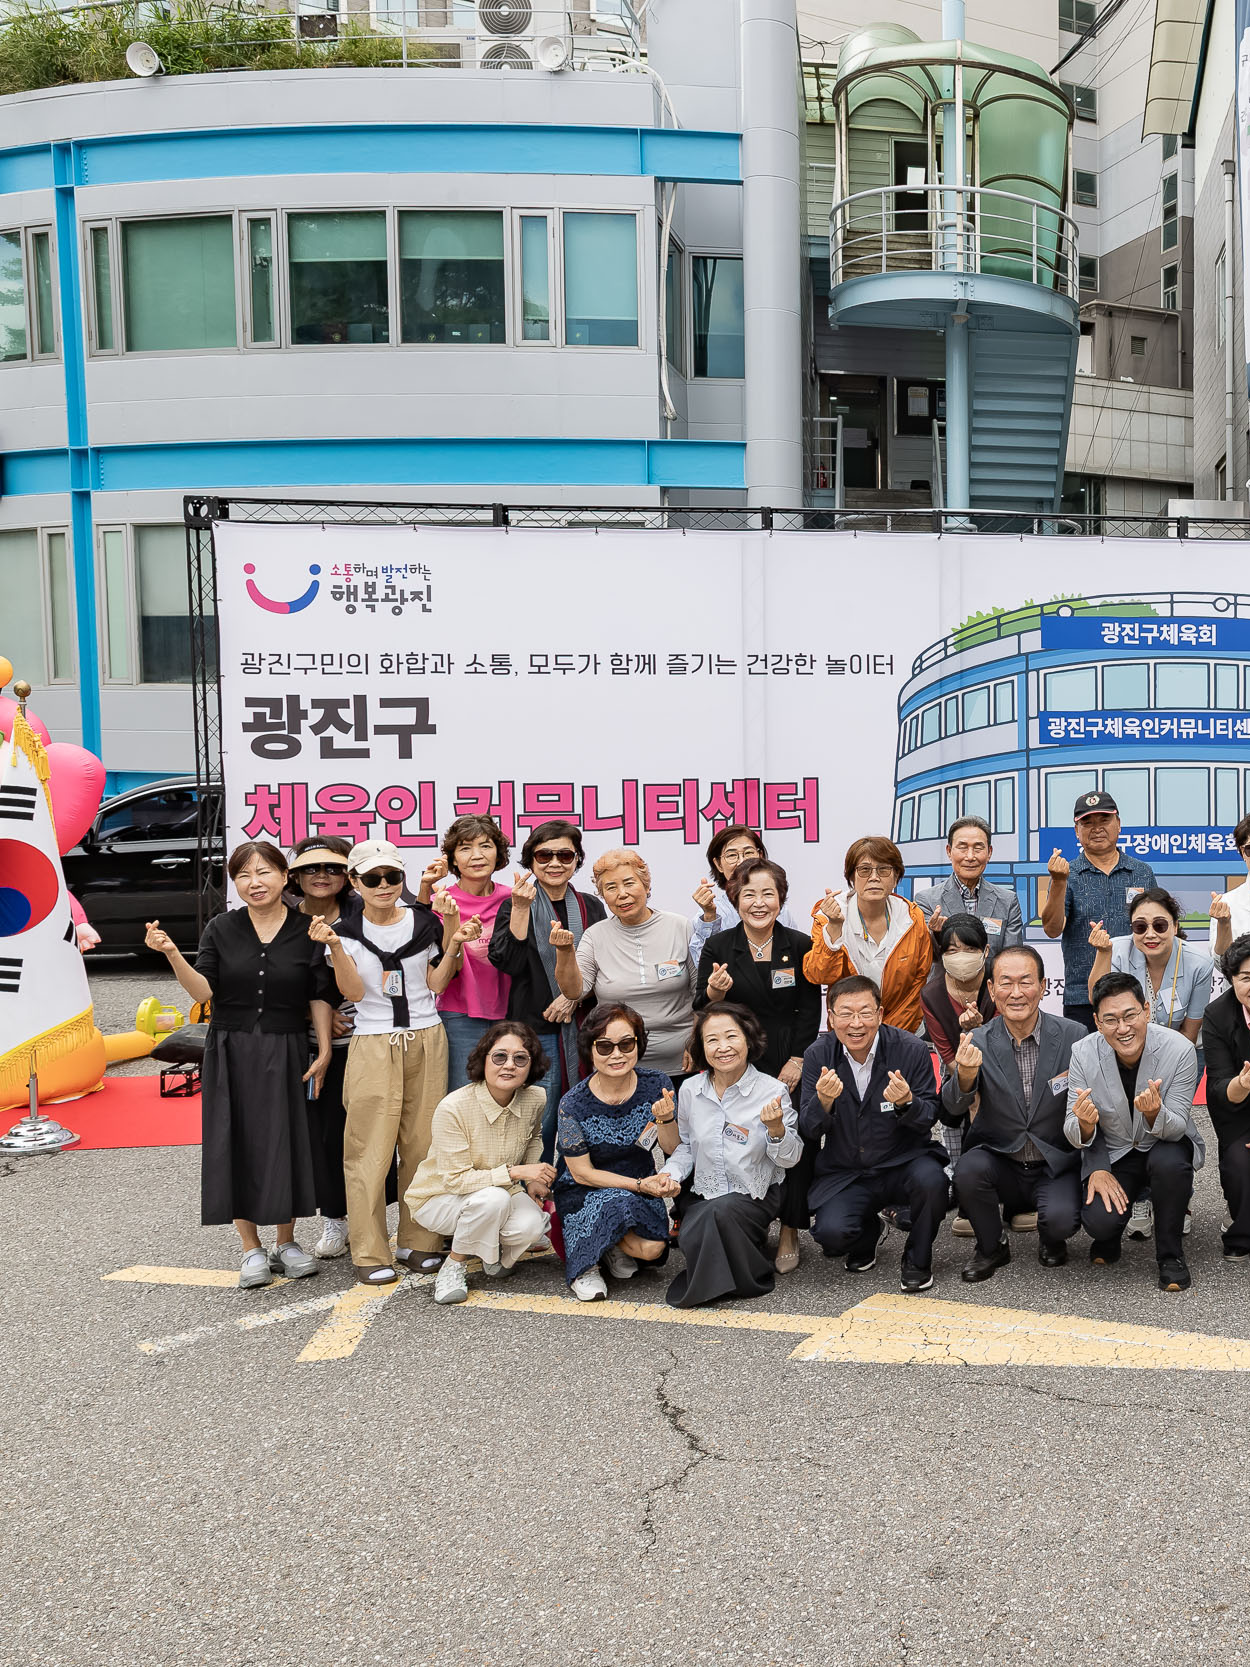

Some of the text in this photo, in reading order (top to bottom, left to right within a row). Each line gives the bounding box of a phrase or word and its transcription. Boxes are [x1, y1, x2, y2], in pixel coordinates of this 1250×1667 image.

[330, 562, 432, 584] 소통하며 발전하는
[330, 581, 432, 617] 행복광진
[1100, 622, 1217, 646] 광진구체육회
[240, 652, 895, 677] 광진구민의 화합과 소통, 모두가 함께 즐기는 건강한 놀이터
[241, 694, 437, 760] 광진구
[241, 777, 820, 848] 체육인 커뮤니티센터
[1076, 833, 1241, 855] 구장애인체육회
